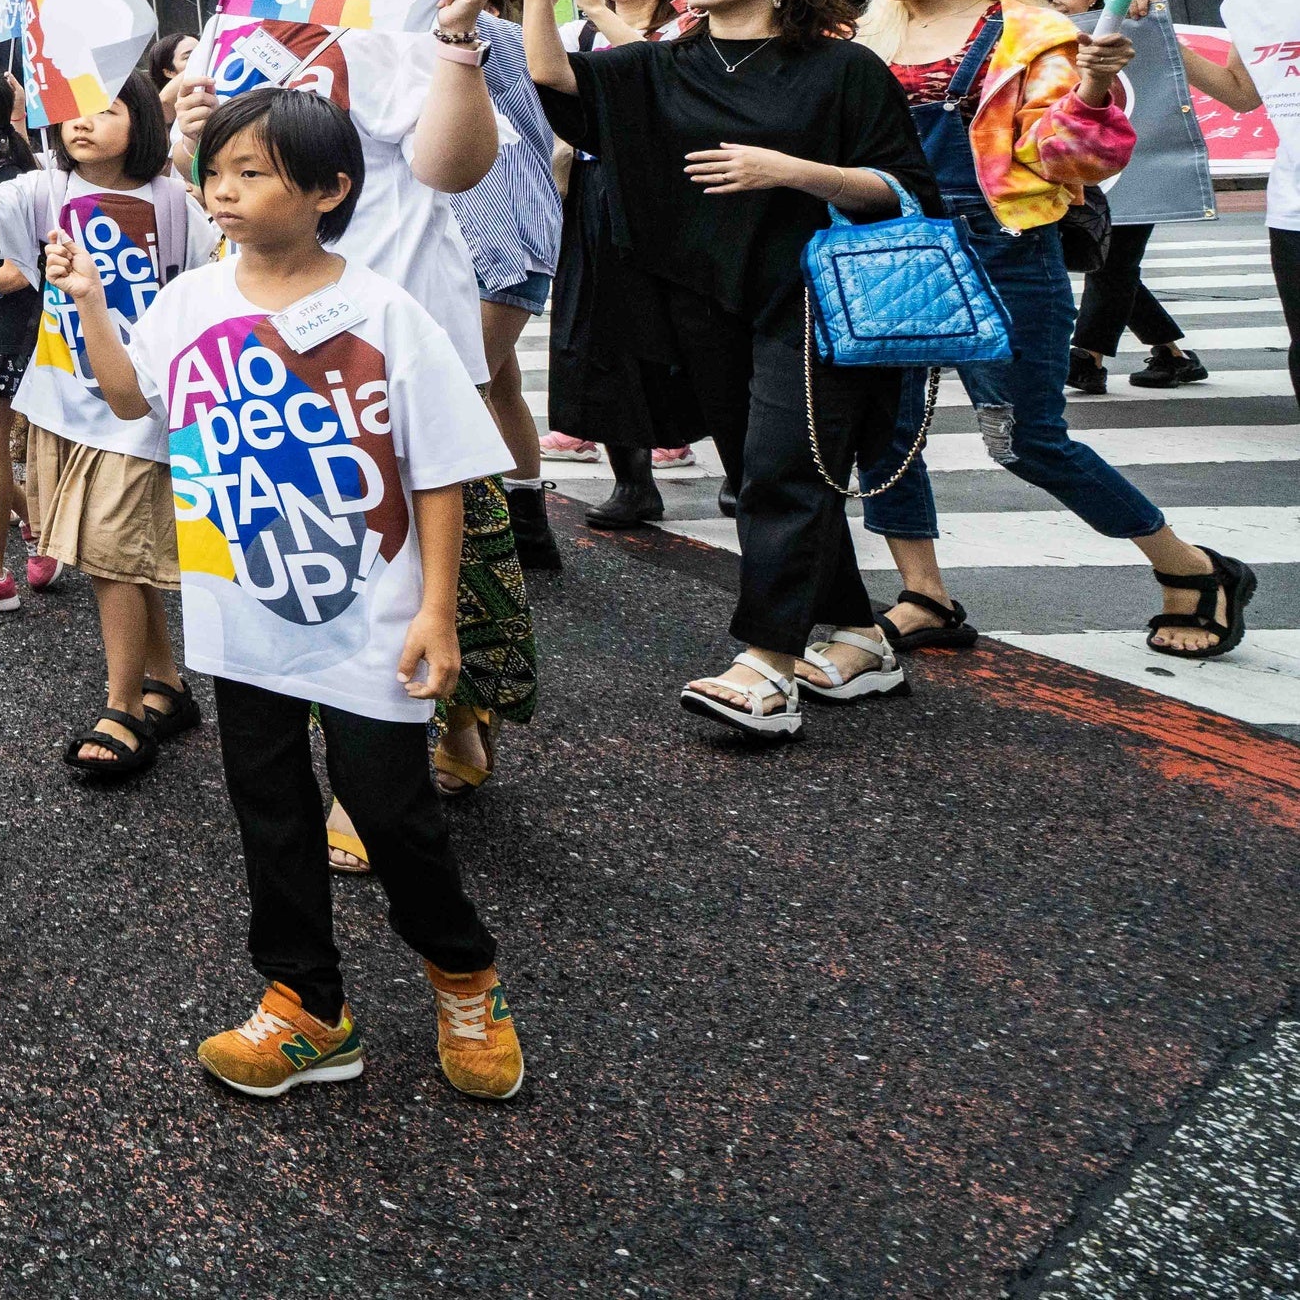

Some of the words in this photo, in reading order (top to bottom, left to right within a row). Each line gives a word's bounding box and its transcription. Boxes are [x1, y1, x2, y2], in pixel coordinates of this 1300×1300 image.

[1275, 102, 1300, 110] promo
[296, 302, 349, 336] かんたろう
[299, 300, 324, 317] STAFF
[168, 336, 286, 431] Alo
[198, 370, 390, 458] pecia
[171, 443, 386, 551] STAND
[233, 530, 383, 622] UP!
